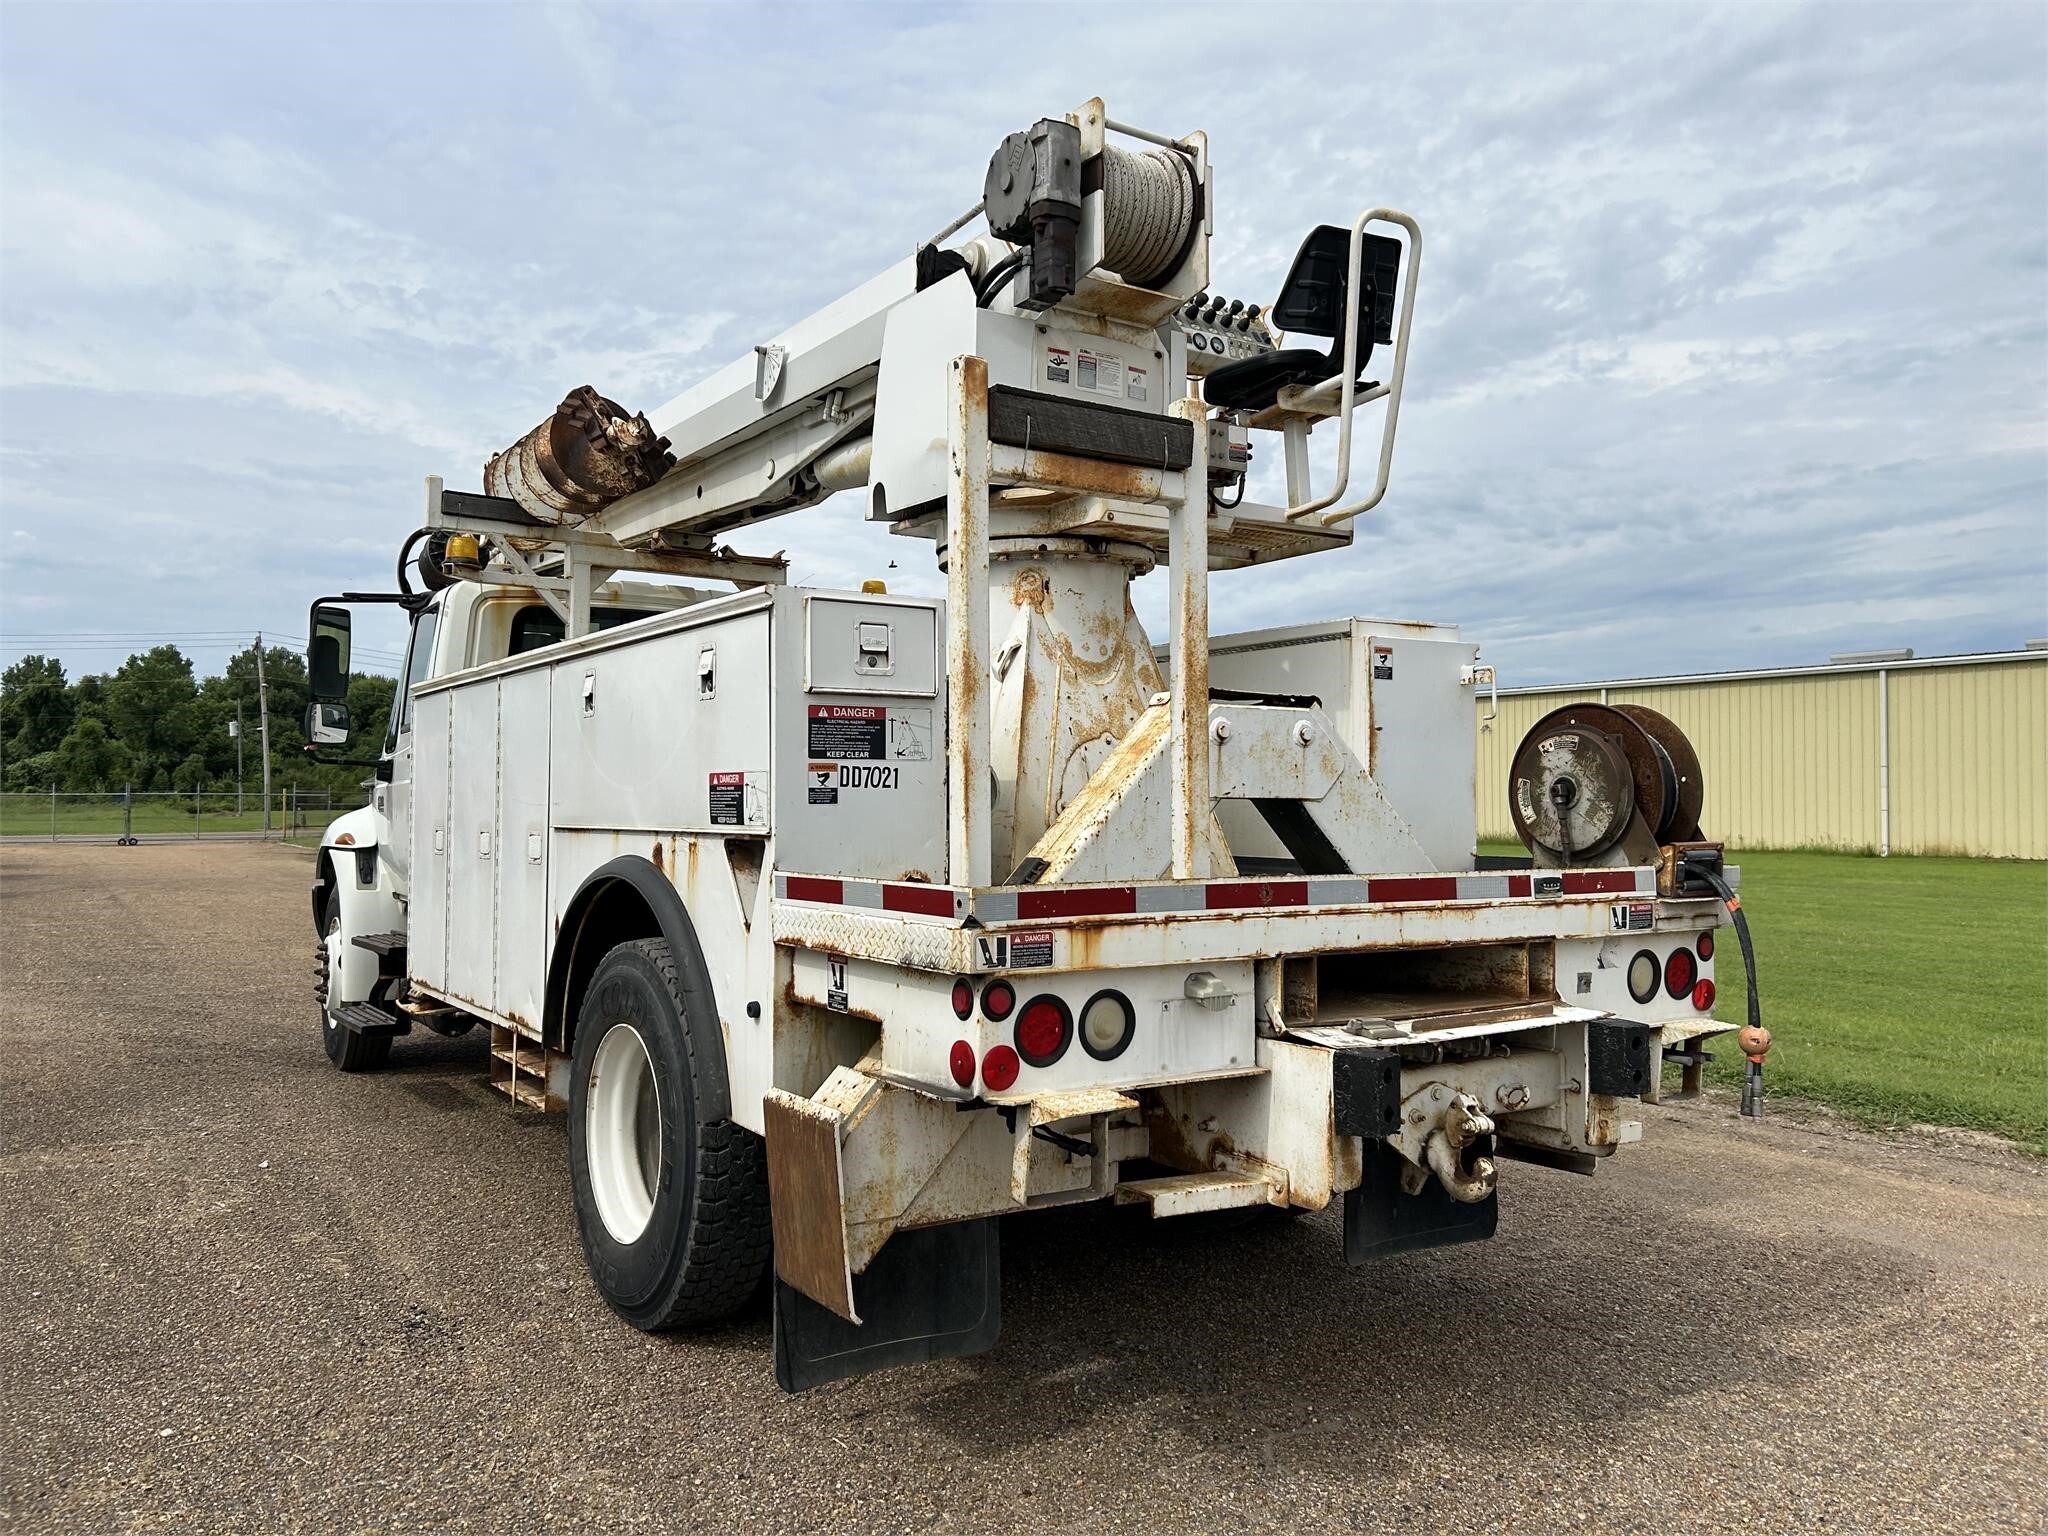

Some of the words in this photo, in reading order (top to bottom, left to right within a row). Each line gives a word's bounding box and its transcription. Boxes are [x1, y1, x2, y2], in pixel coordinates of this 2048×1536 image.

[833, 707, 875, 717] DANGER
[719, 774, 740, 783] DANGER
[840, 765, 898, 789] DD7021
[1024, 934, 1049, 942] DANGER
